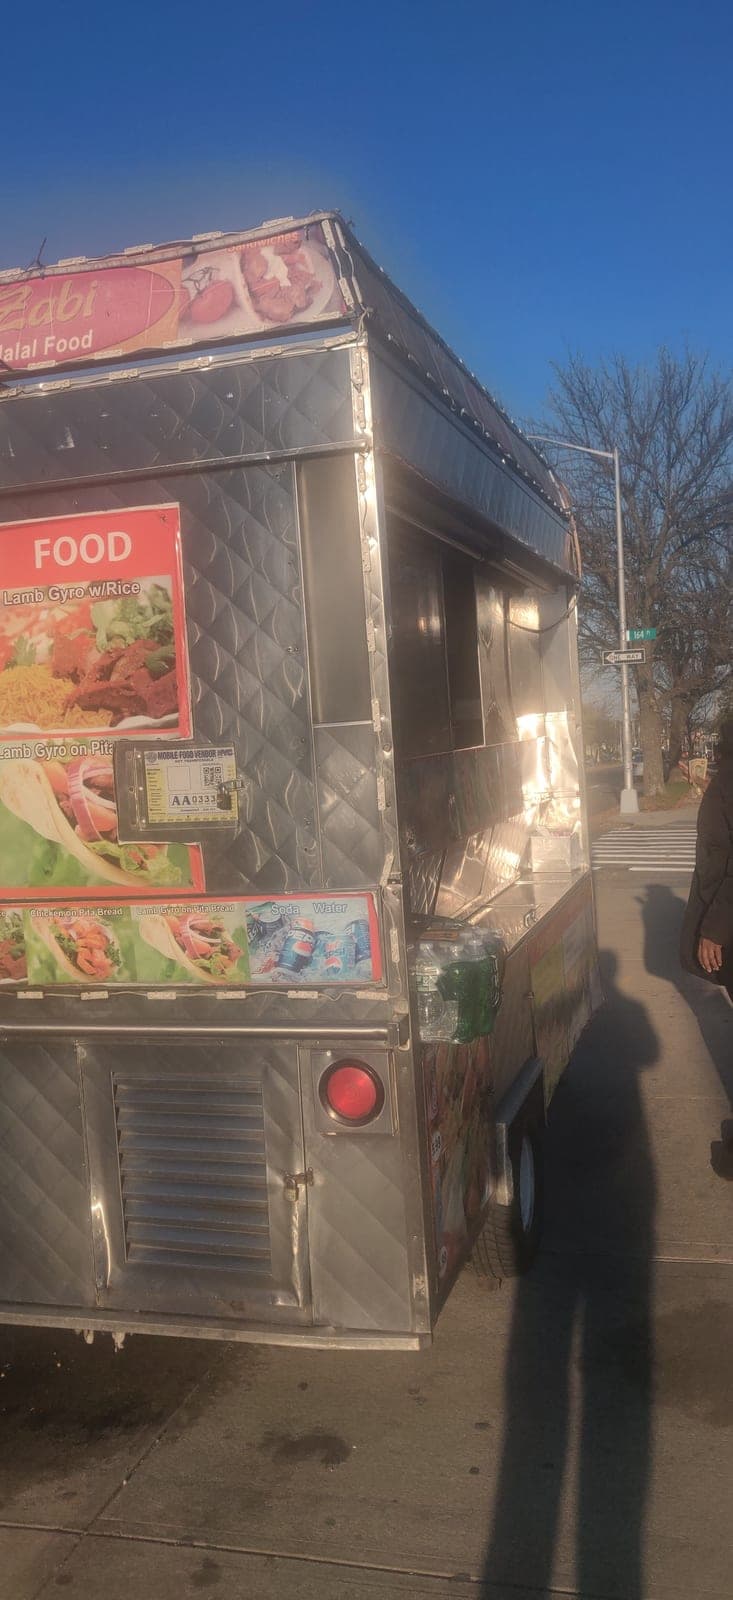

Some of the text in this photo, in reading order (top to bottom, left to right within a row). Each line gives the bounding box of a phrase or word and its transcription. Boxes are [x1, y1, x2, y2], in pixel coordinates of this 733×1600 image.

[0, 329, 94, 361] alal Food
[34, 531, 132, 569] FOOD
[3, 580, 141, 605] Lamb Gyro w/Rice
[34, 743, 67, 761] Gyro
[70, 744, 87, 756] on
[158, 751, 178, 760] MOBILE
[180, 750, 194, 759] FOOD
[97, 907, 123, 916] Bread
[271, 902, 347, 915] Soda Water
